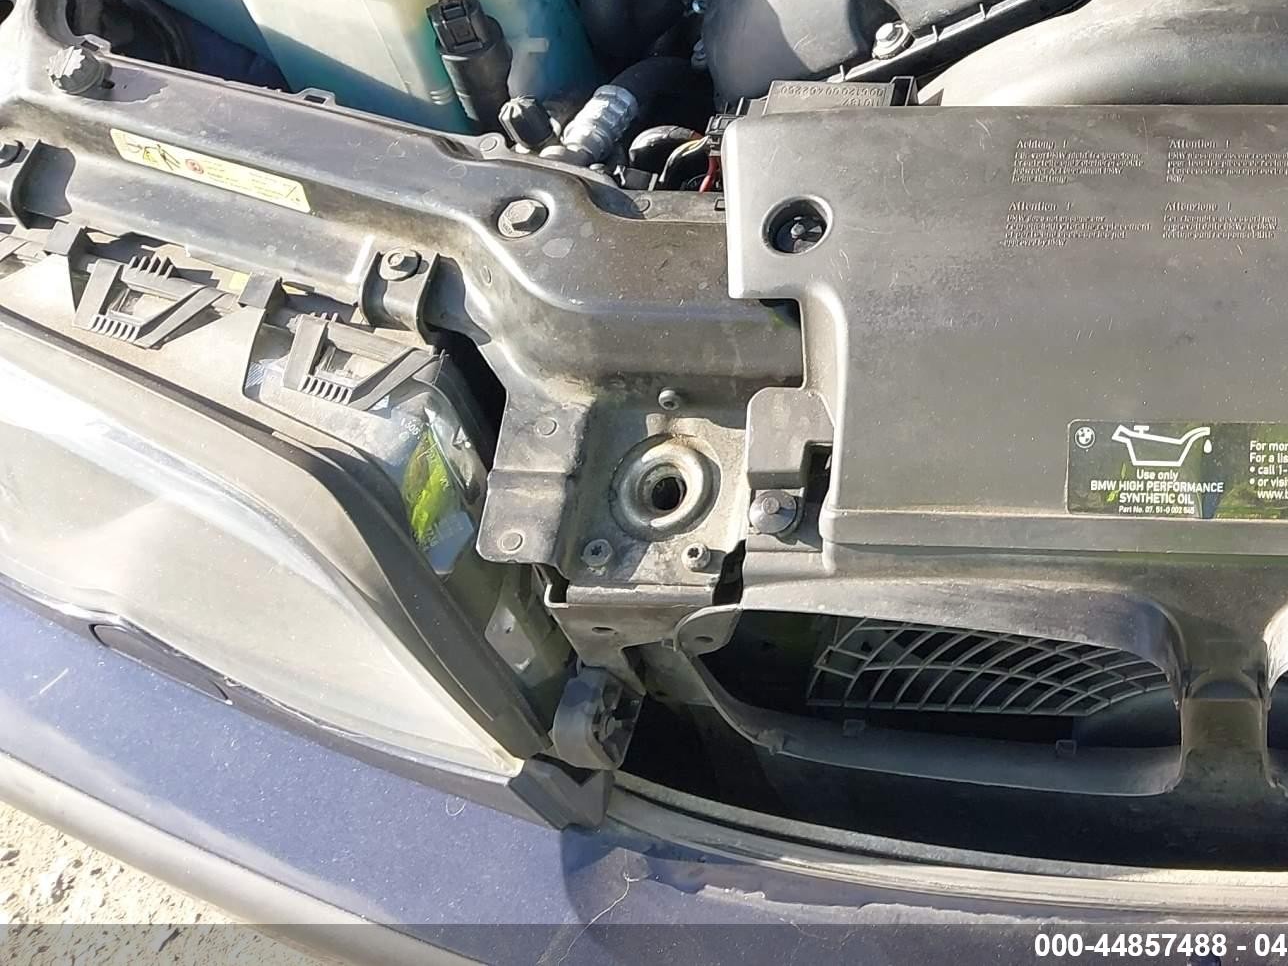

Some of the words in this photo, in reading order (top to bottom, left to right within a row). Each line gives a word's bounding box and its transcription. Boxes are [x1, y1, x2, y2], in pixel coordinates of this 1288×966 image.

[1250, 440, 1266, 451] For
[1250, 452, 1266, 463] For
[1268, 455, 1275, 463] a
[1136, 468, 1155, 480] Use
[1158, 469, 1179, 483] only
[1258, 465, 1275, 475] call
[1090, 480, 1118, 491] BMW
[1119, 480, 1144, 491] HIGH
[1146, 481, 1224, 493] PERFORMANCE
[1119, 492, 1176, 504] SYNTHETIC
[1177, 493, 1194, 505] OIL
[1119, 505, 1132, 514] Part
[1133, 505, 1144, 514] No.
